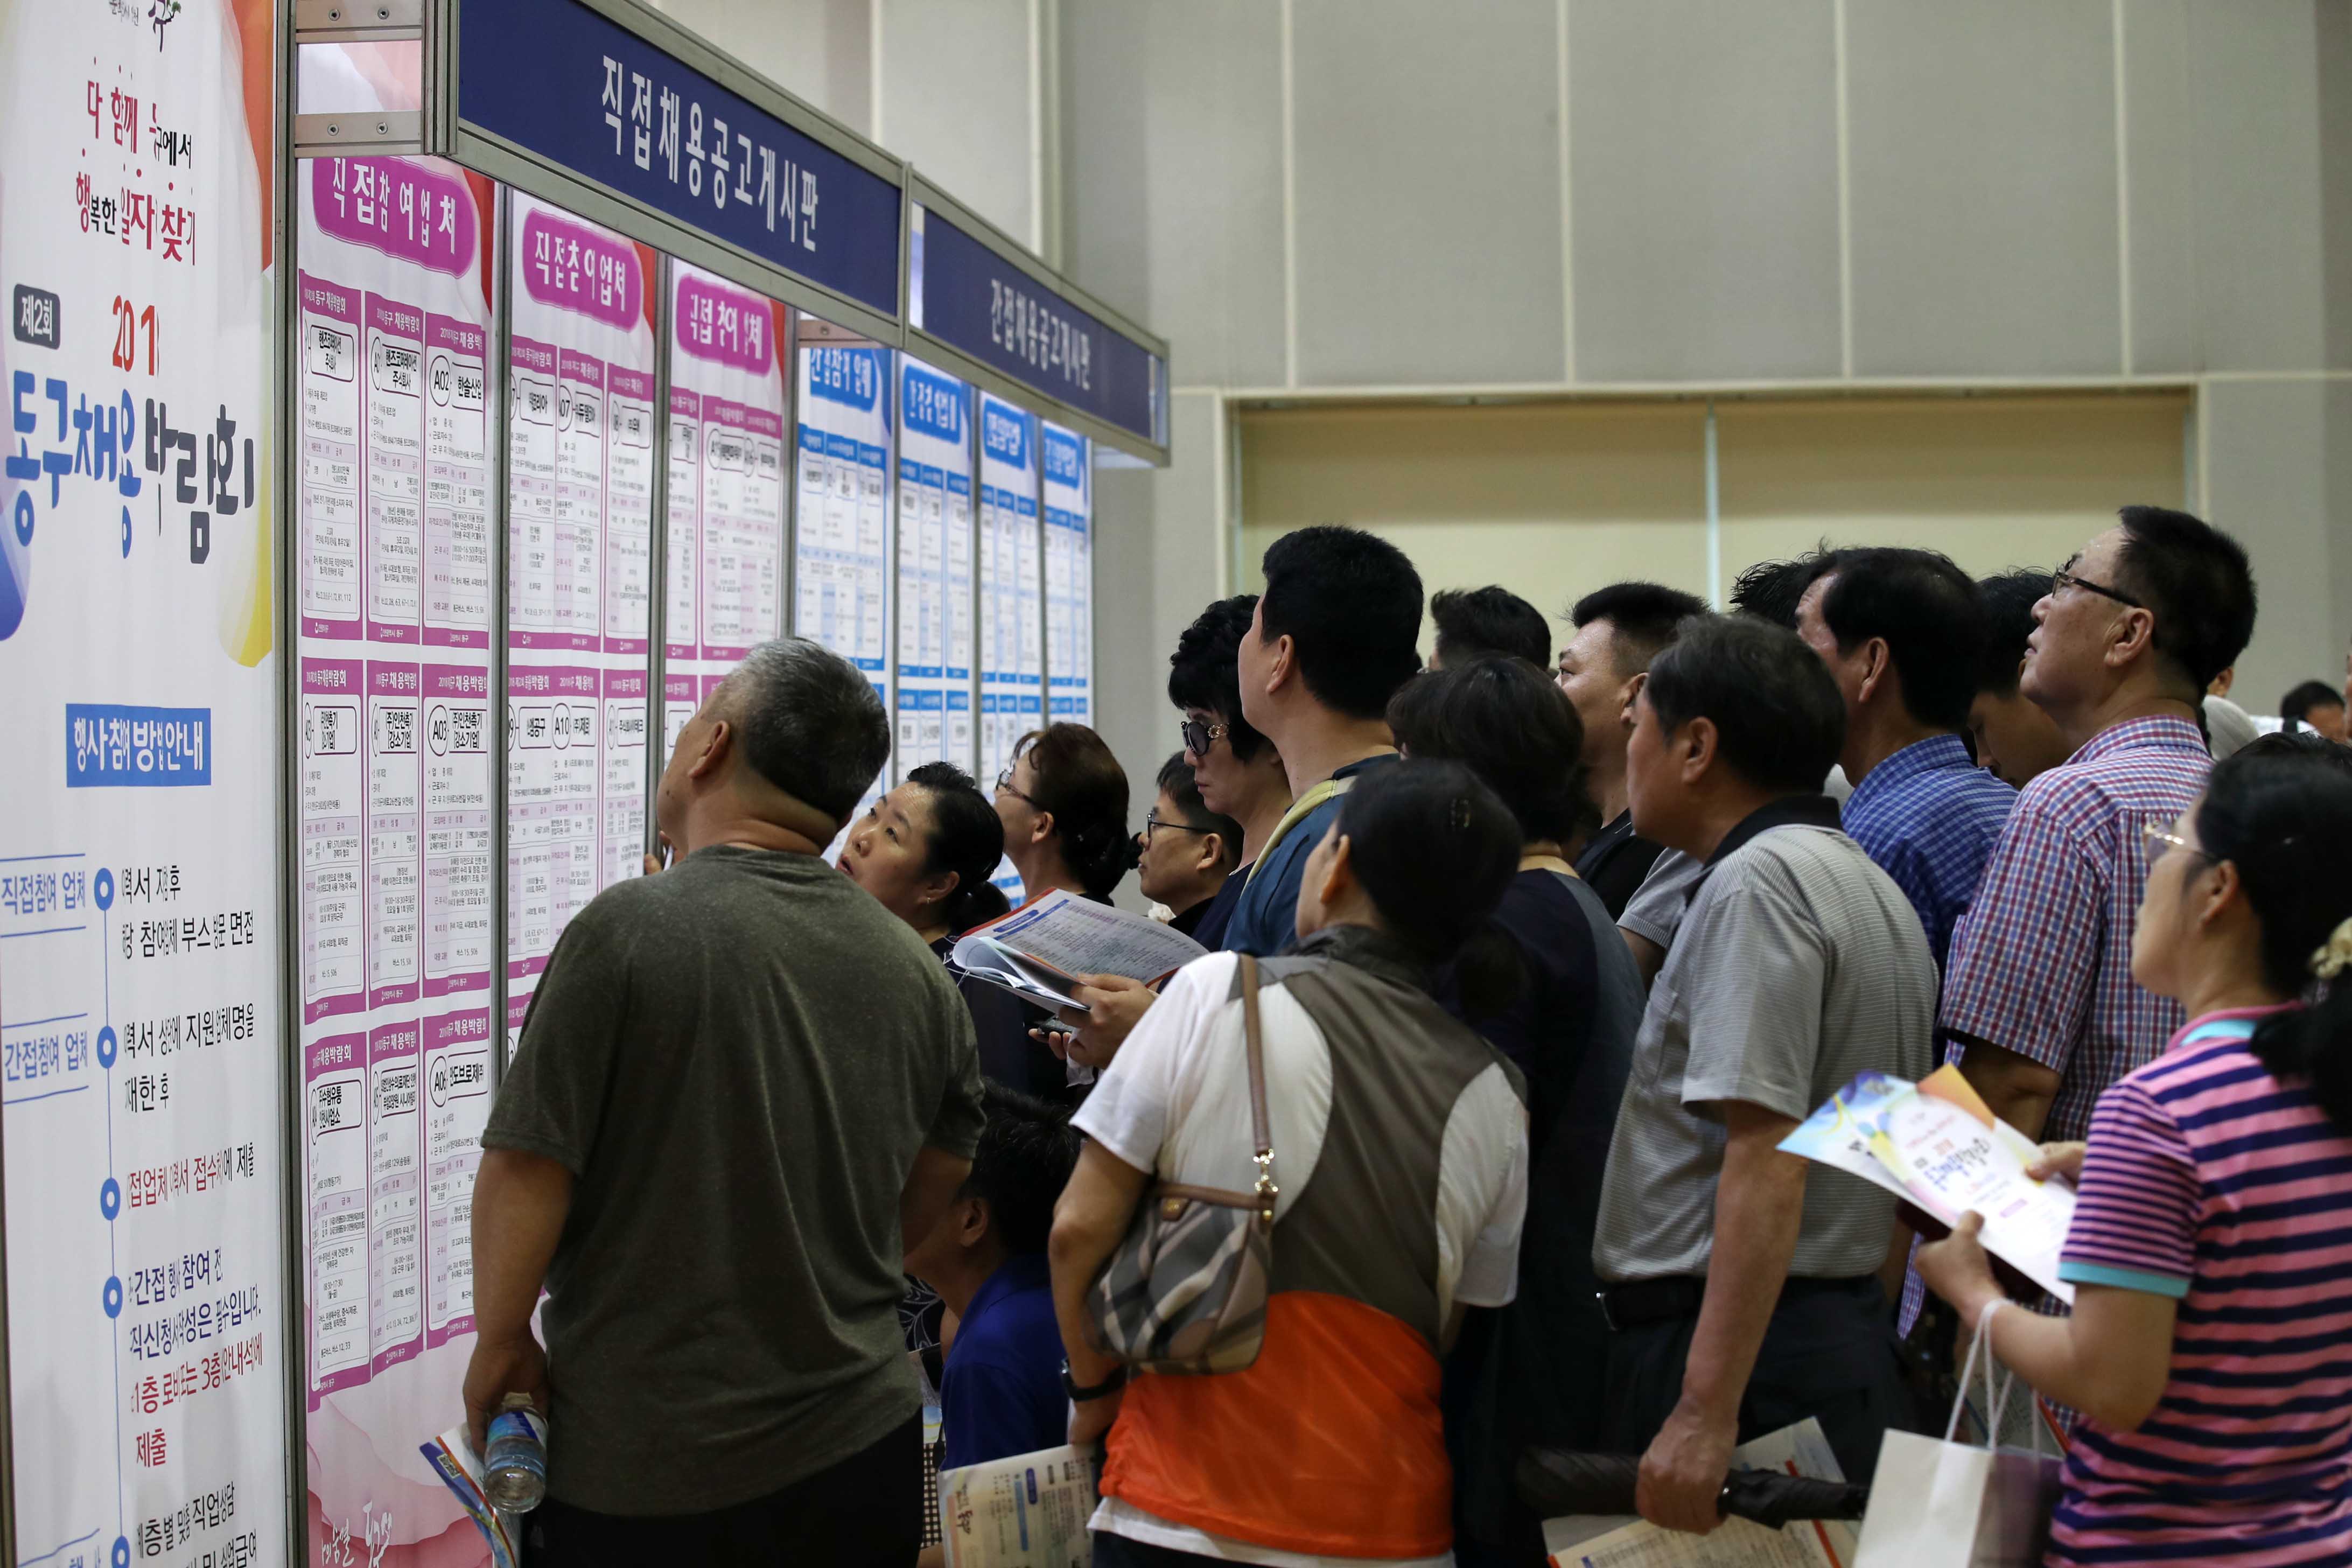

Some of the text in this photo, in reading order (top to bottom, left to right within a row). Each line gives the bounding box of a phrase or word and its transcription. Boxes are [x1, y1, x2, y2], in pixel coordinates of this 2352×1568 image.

[88, 80, 102, 138] 다
[602, 55, 819, 252] 직접채용공고게시판
[76, 172, 116, 234] 행복한
[122, 186, 158, 249] 일자
[22, 294, 52, 341] 제2회
[113, 295, 159, 378] 201
[434, 370, 449, 391] A02
[559, 400, 570, 418] 07
[433, 720, 447, 740] A03
[122, 867, 150, 904] 력서
[182, 917, 211, 952] 부스
[124, 1020, 153, 1058] 력서
[391, 1032, 416, 1051] 채용박람
[182, 1250, 209, 1291] 참여
[136, 1429, 166, 1467] 제출
